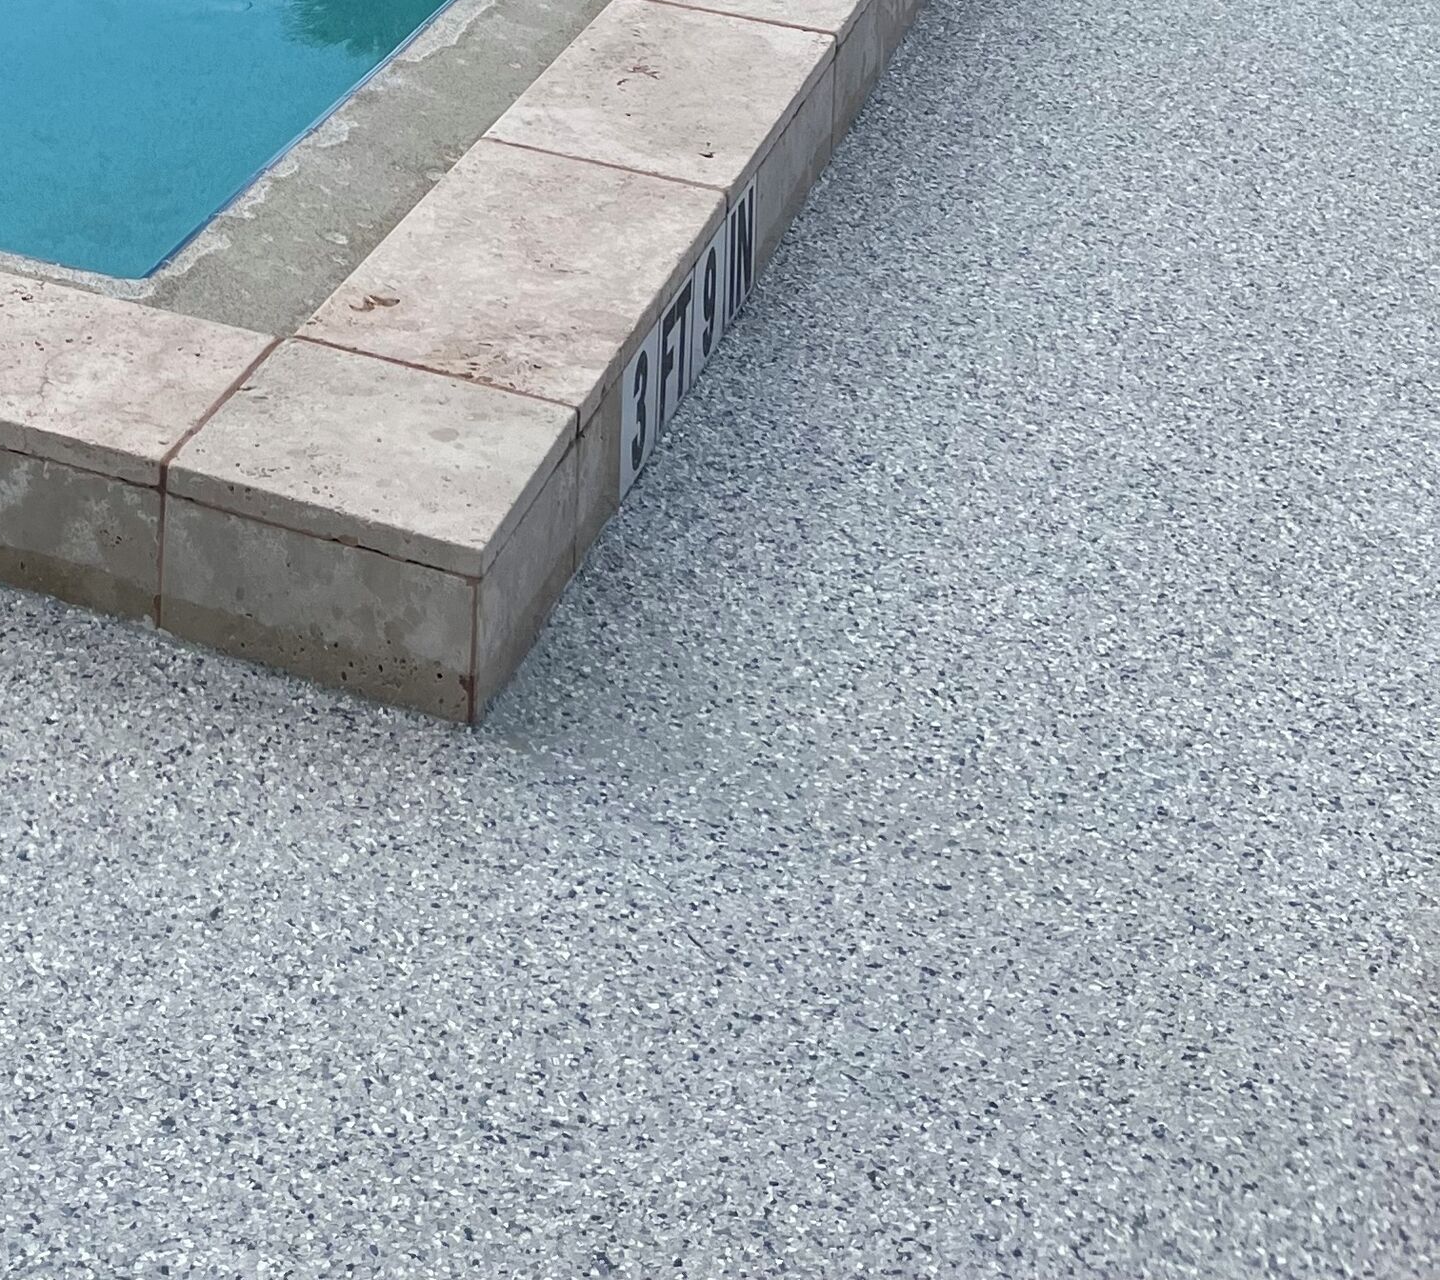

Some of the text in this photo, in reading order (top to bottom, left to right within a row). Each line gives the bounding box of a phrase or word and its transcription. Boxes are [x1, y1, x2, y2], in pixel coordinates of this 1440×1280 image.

[631, 185, 754, 471] 3 FT 9 IN
